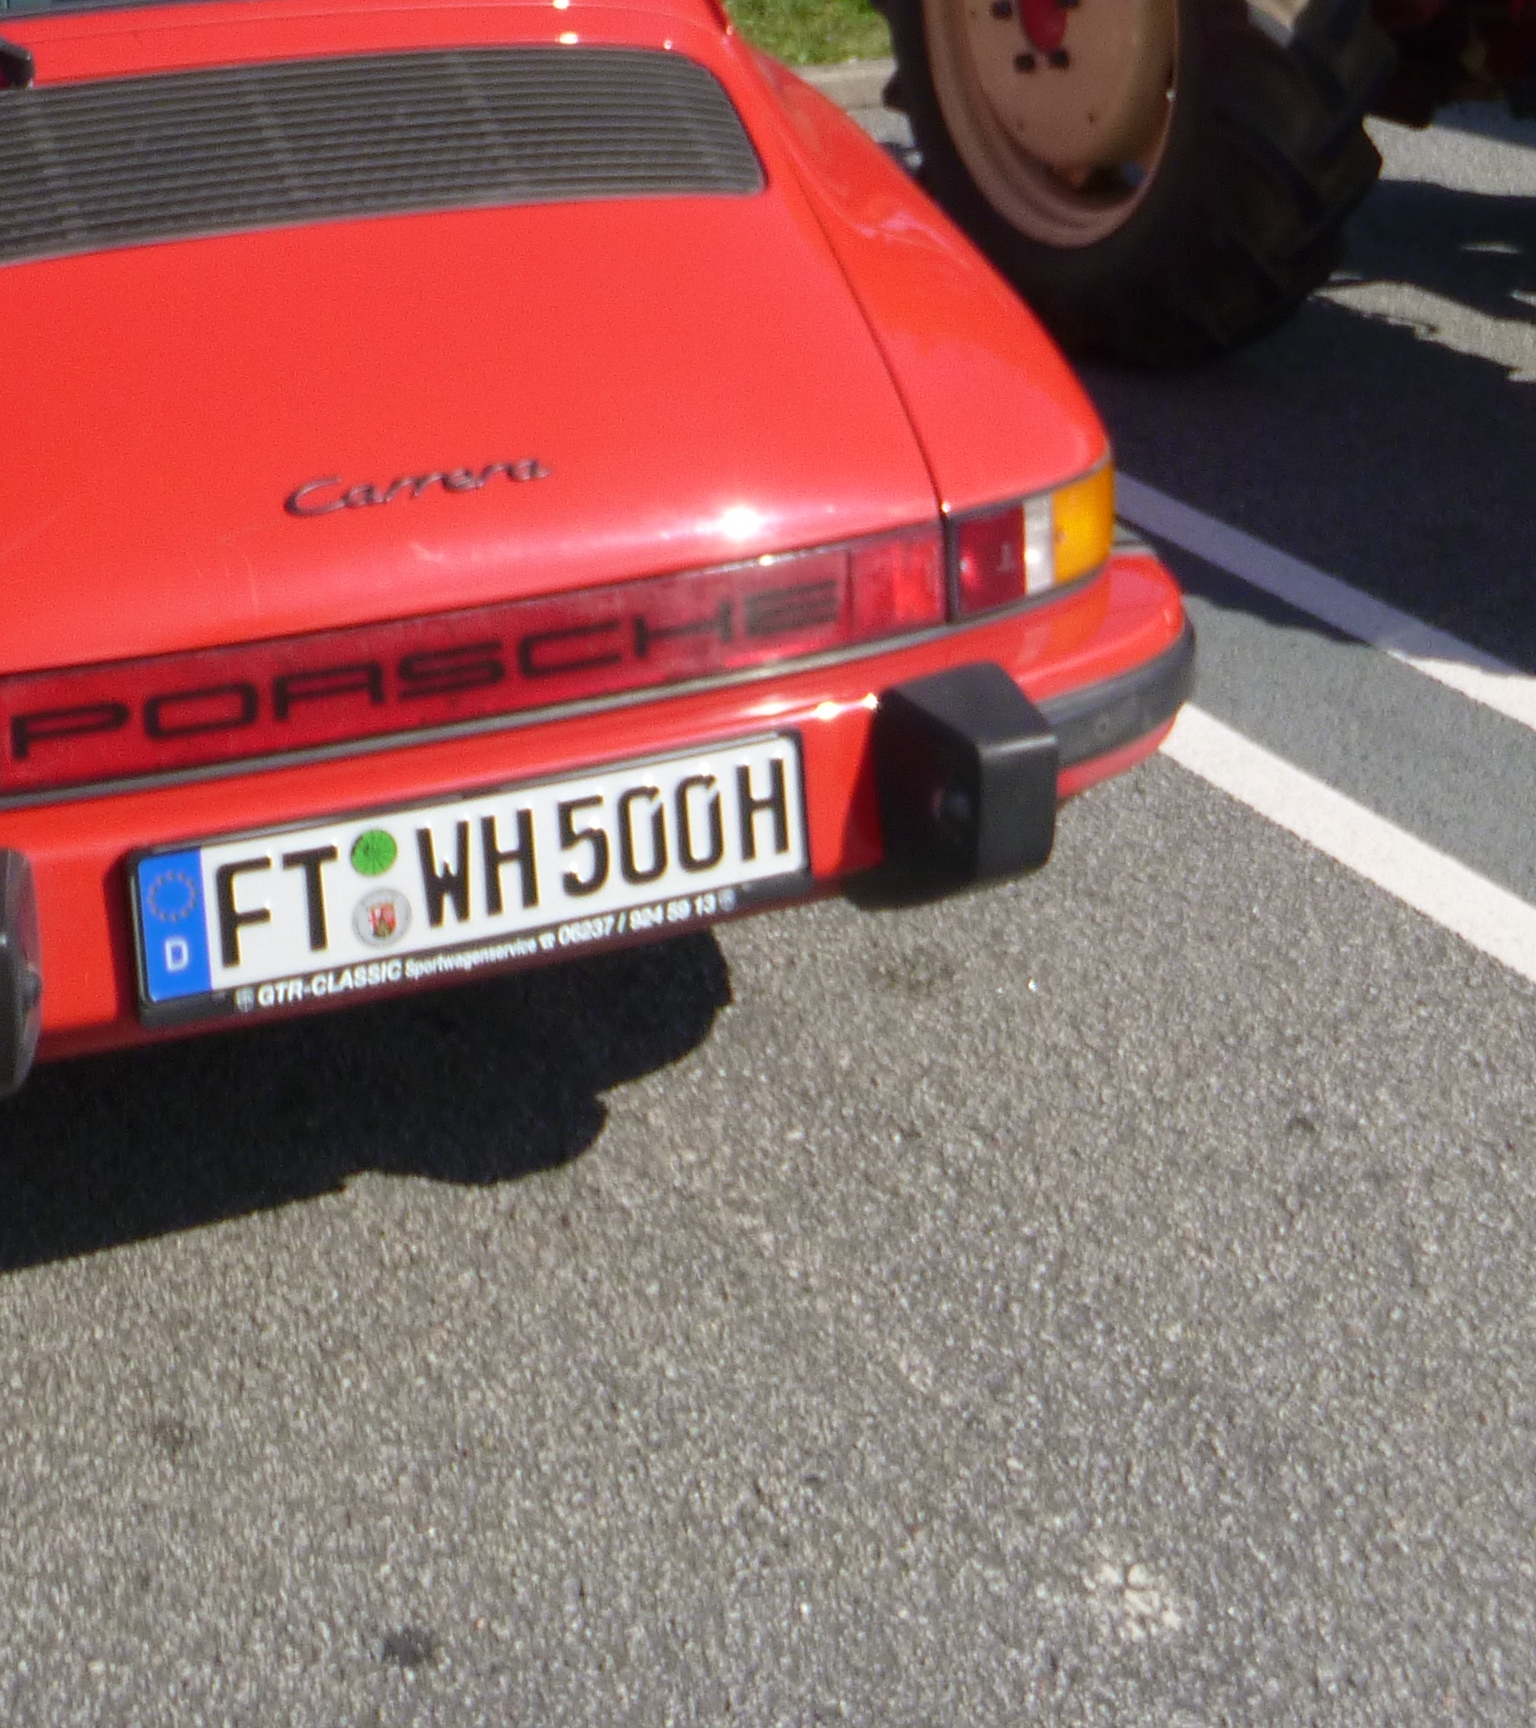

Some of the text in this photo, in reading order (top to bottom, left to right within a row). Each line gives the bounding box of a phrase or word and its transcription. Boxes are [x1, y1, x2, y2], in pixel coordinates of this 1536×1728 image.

[284, 458, 552, 518] Carrera
[10, 576, 841, 761] PORSCHE
[214, 845, 339, 968] FT
[165, 937, 190, 974] D
[257, 958, 403, 1007] GTR-CLASSIC
